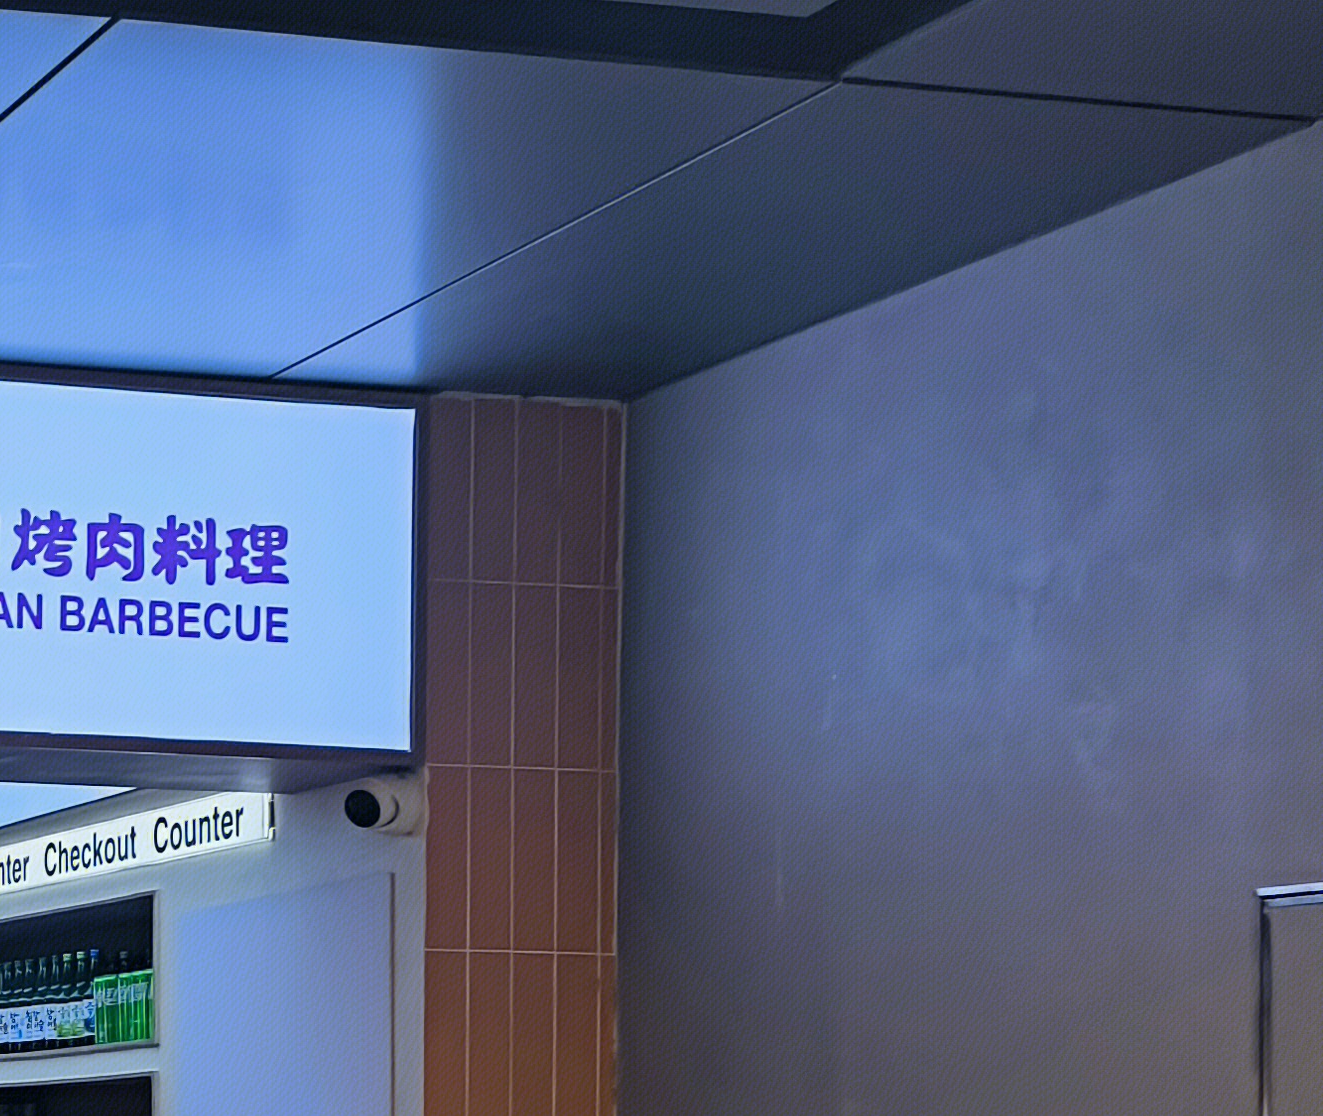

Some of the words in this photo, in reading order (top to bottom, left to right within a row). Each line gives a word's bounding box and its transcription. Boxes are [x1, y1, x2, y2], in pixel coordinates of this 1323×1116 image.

[59, 594, 290, 643] BARBECUE
[44, 826, 136, 877] Checkout
[153, 805, 245, 853] Counter
